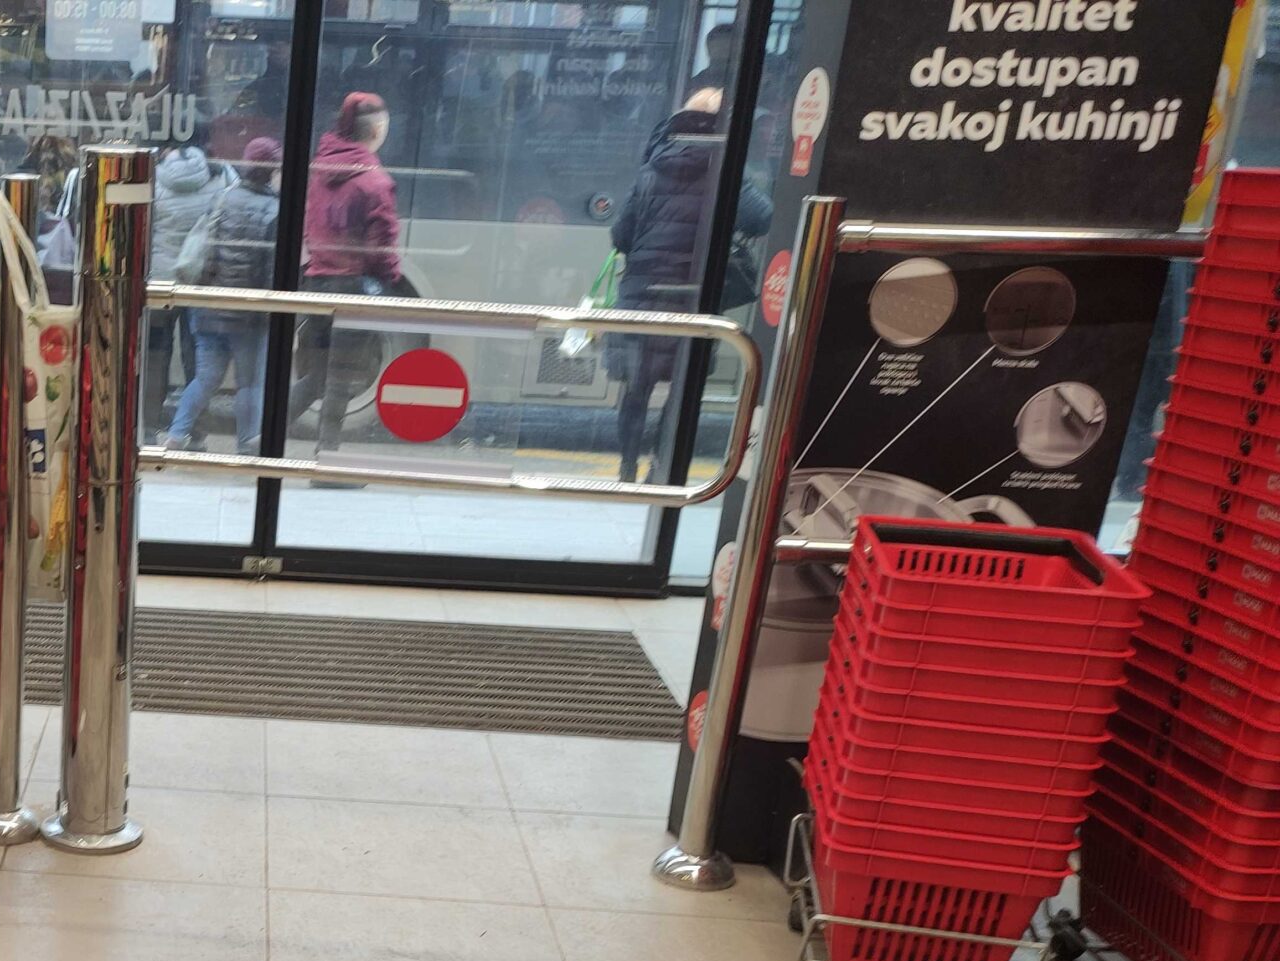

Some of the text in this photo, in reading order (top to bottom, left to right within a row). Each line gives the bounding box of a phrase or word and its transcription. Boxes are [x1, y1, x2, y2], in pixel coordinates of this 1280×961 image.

[948, 0, 1138, 33] kvalitet
[909, 46, 1140, 97] dostupan
[858, 98, 1013, 152] svakoj
[1015, 98, 1183, 152] kuhinji
